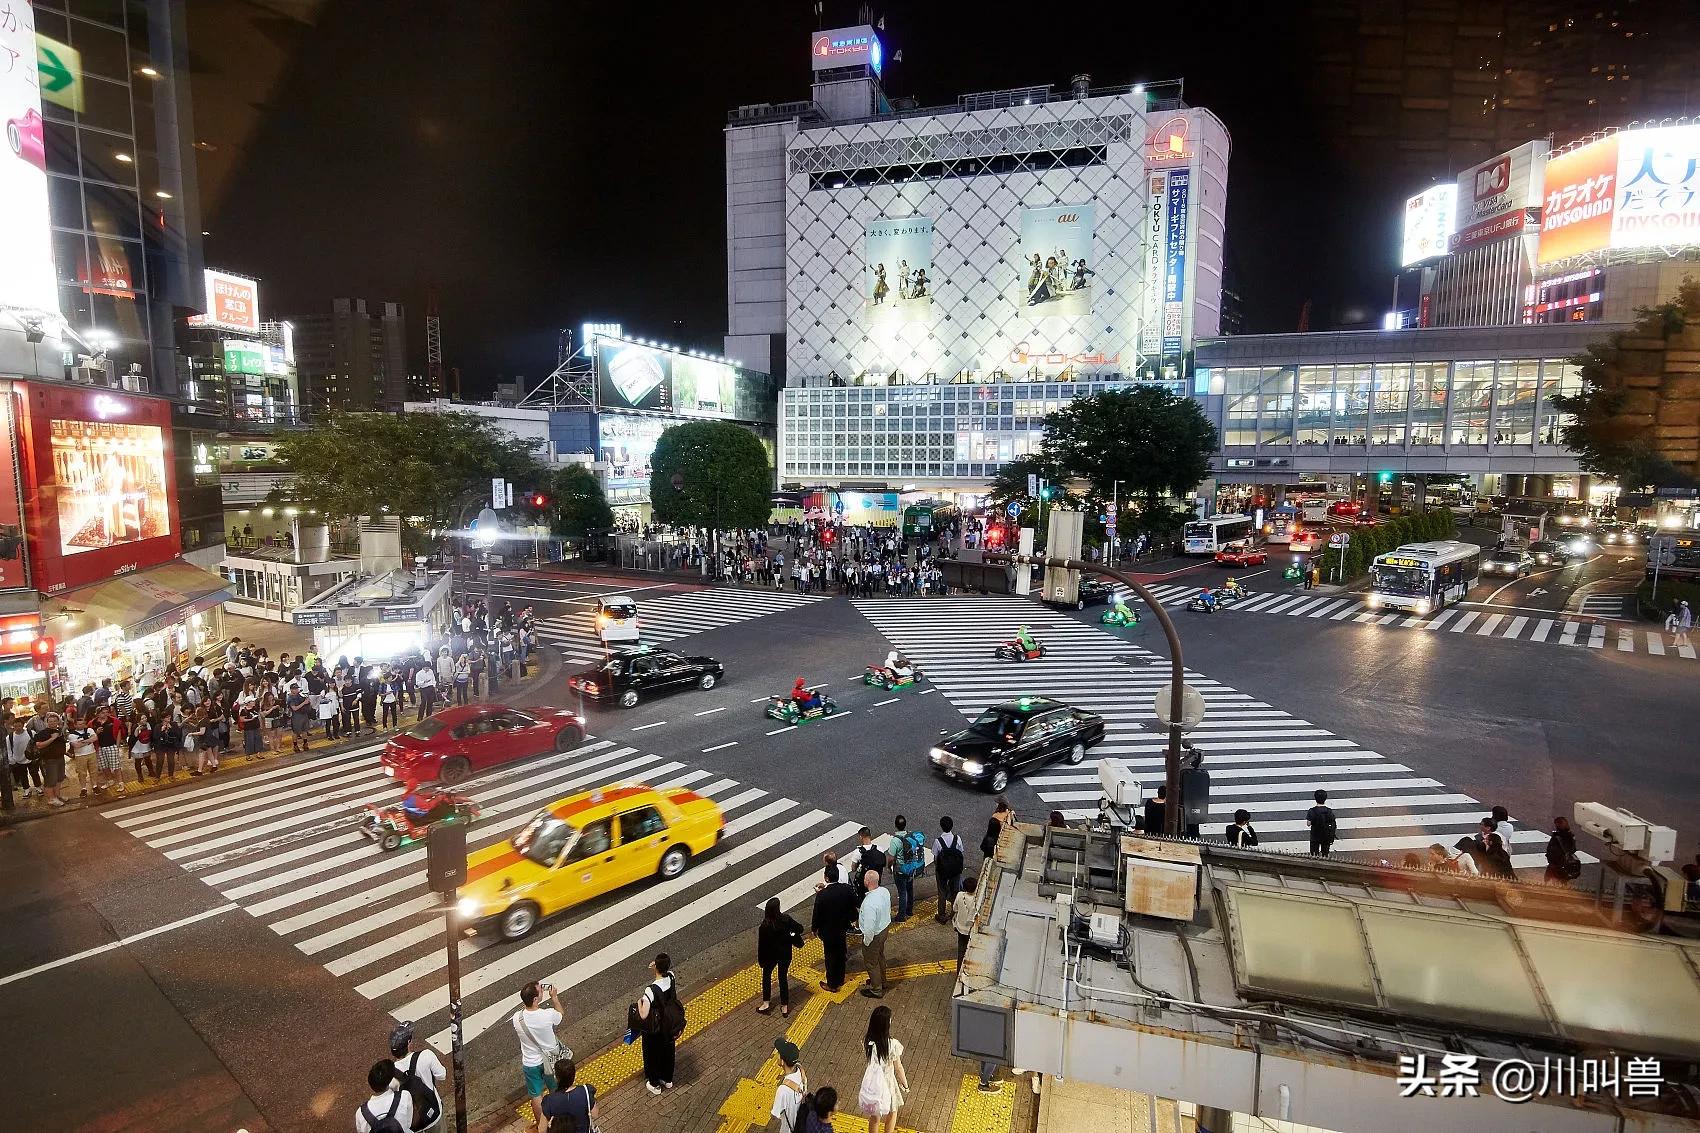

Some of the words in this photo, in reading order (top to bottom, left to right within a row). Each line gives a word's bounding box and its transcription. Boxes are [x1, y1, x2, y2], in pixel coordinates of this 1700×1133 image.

[829, 45, 869, 55] TOKYU
[1146, 151, 1195, 161] TOKYU
[1476, 162, 1506, 197] DC
[1545, 174, 1615, 216] カラオケ
[1057, 213, 1080, 224] au
[1152, 195, 1162, 232] TOKYU
[1542, 197, 1613, 232] JOYSOUND
[1617, 212, 1700, 232] JOYSOU
[870, 227, 929, 238] 大きく、変わります。
[1465, 216, 1519, 242] 三菱東京UFJ銀行
[1151, 234, 1159, 264] CARD
[215, 282, 251, 300] ほけんの
[221, 311, 249, 324] グループ
[229, 352, 237, 371] レイク
[243, 356, 260, 368] レイク
[1028, 351, 1121, 365] TOKYU
[223, 482, 240, 491] JR
